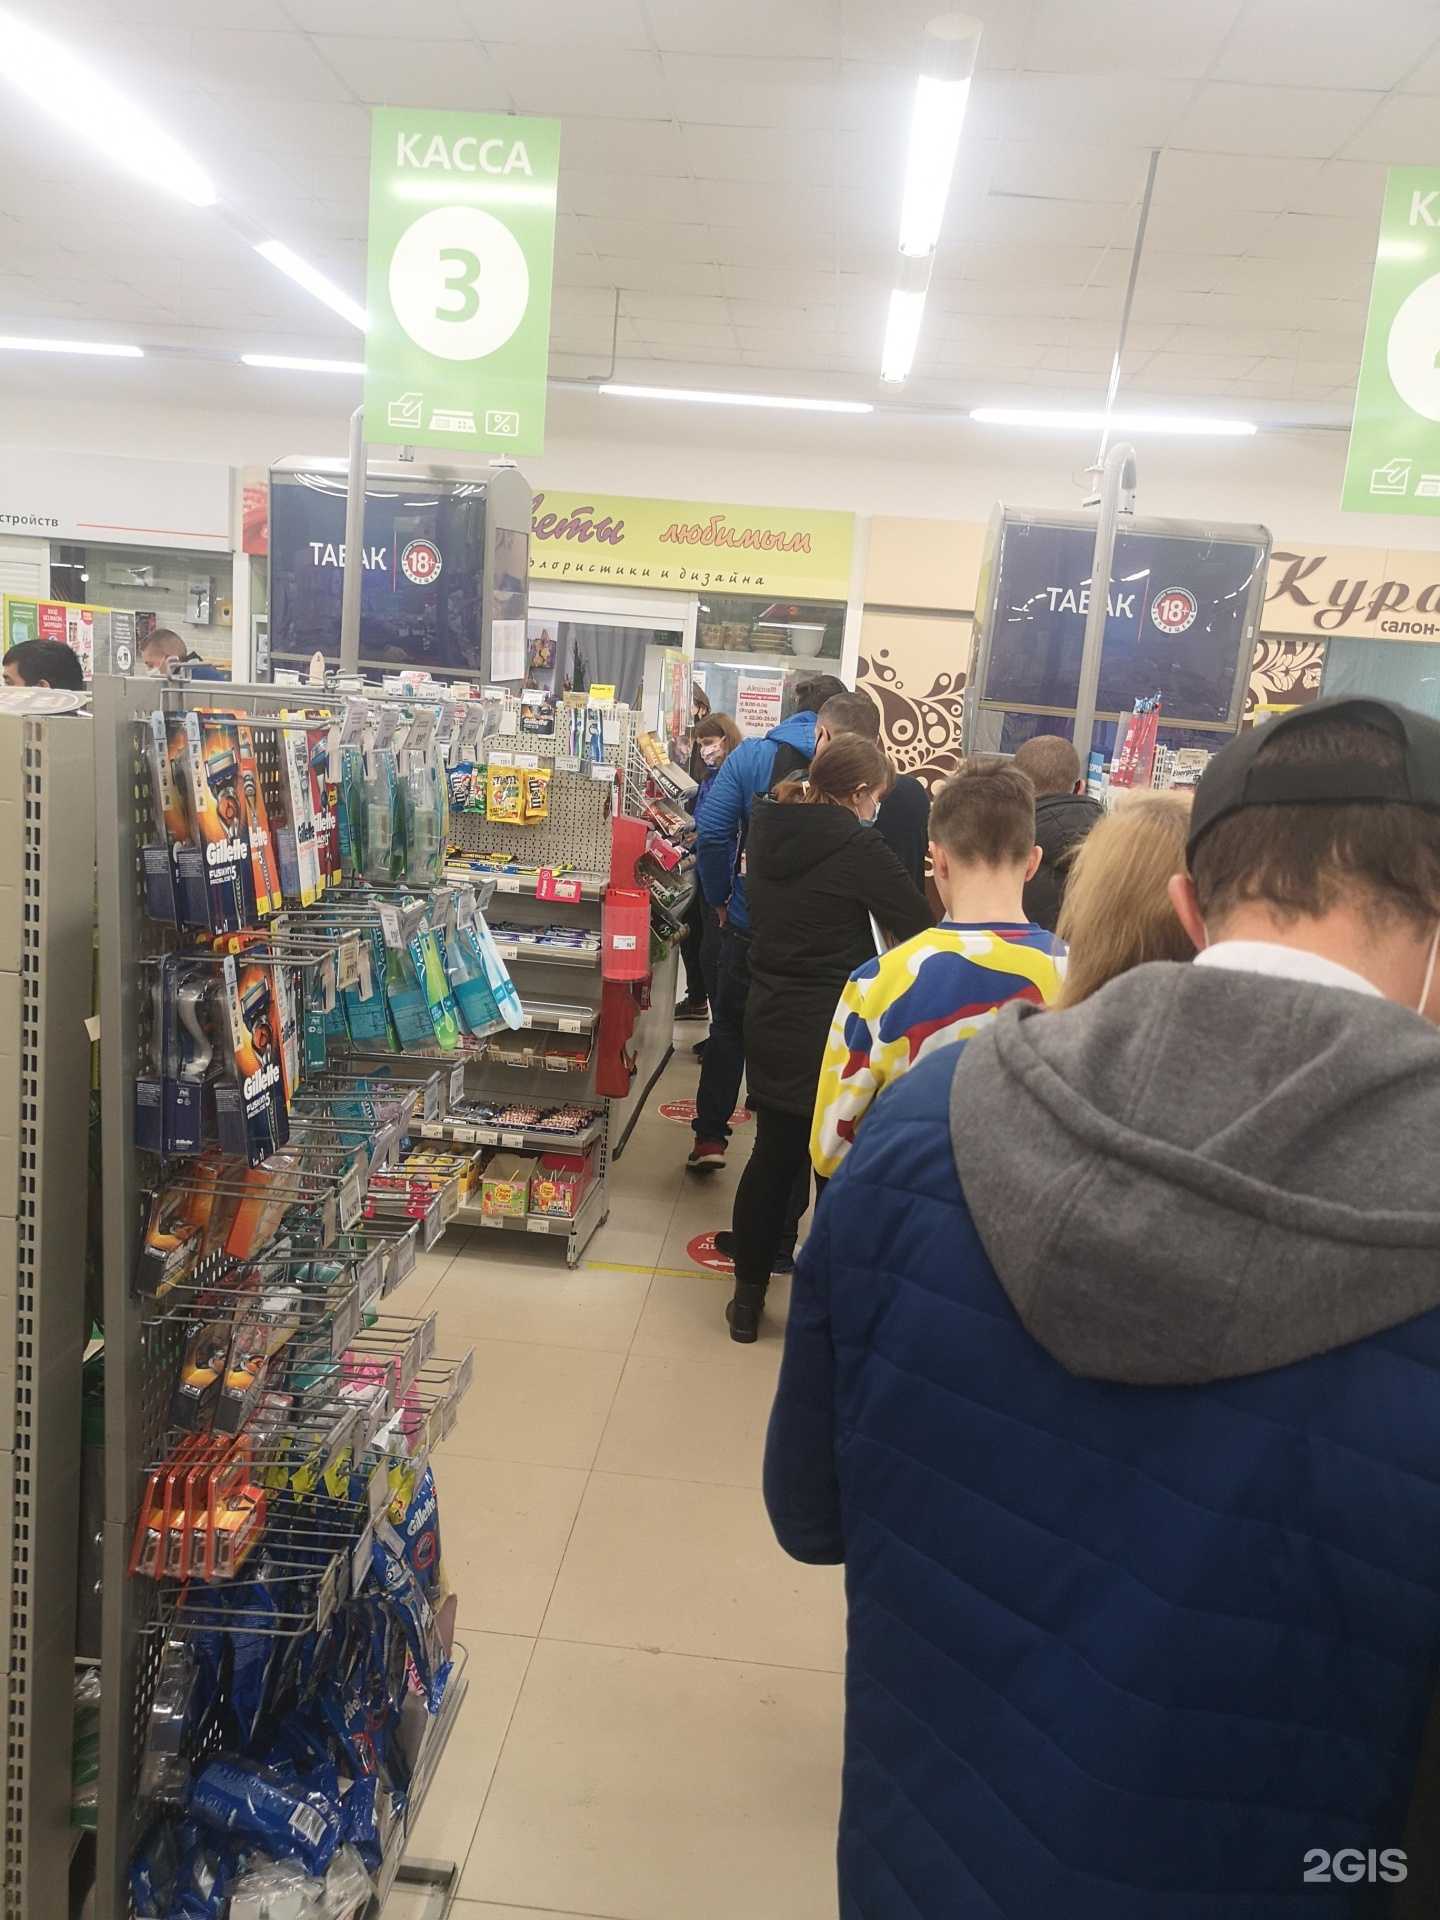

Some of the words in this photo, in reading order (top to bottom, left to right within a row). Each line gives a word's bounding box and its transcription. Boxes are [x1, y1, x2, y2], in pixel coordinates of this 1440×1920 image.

[396, 131, 534, 177] КАССА
[1408, 190, 1440, 227] К
[434, 247, 482, 323] 3
[0, 513, 59, 528] стройств
[659, 514, 813, 554] любимым
[408, 550, 436, 573] 18+
[660, 570, 669, 579] и
[679, 567, 766, 587] дизайна
[1160, 599, 1191, 623] 18+
[206, 839, 248, 867] Gillette
[243, 1064, 281, 1102] Gillette
[407, 1499, 436, 1536] Gillette
